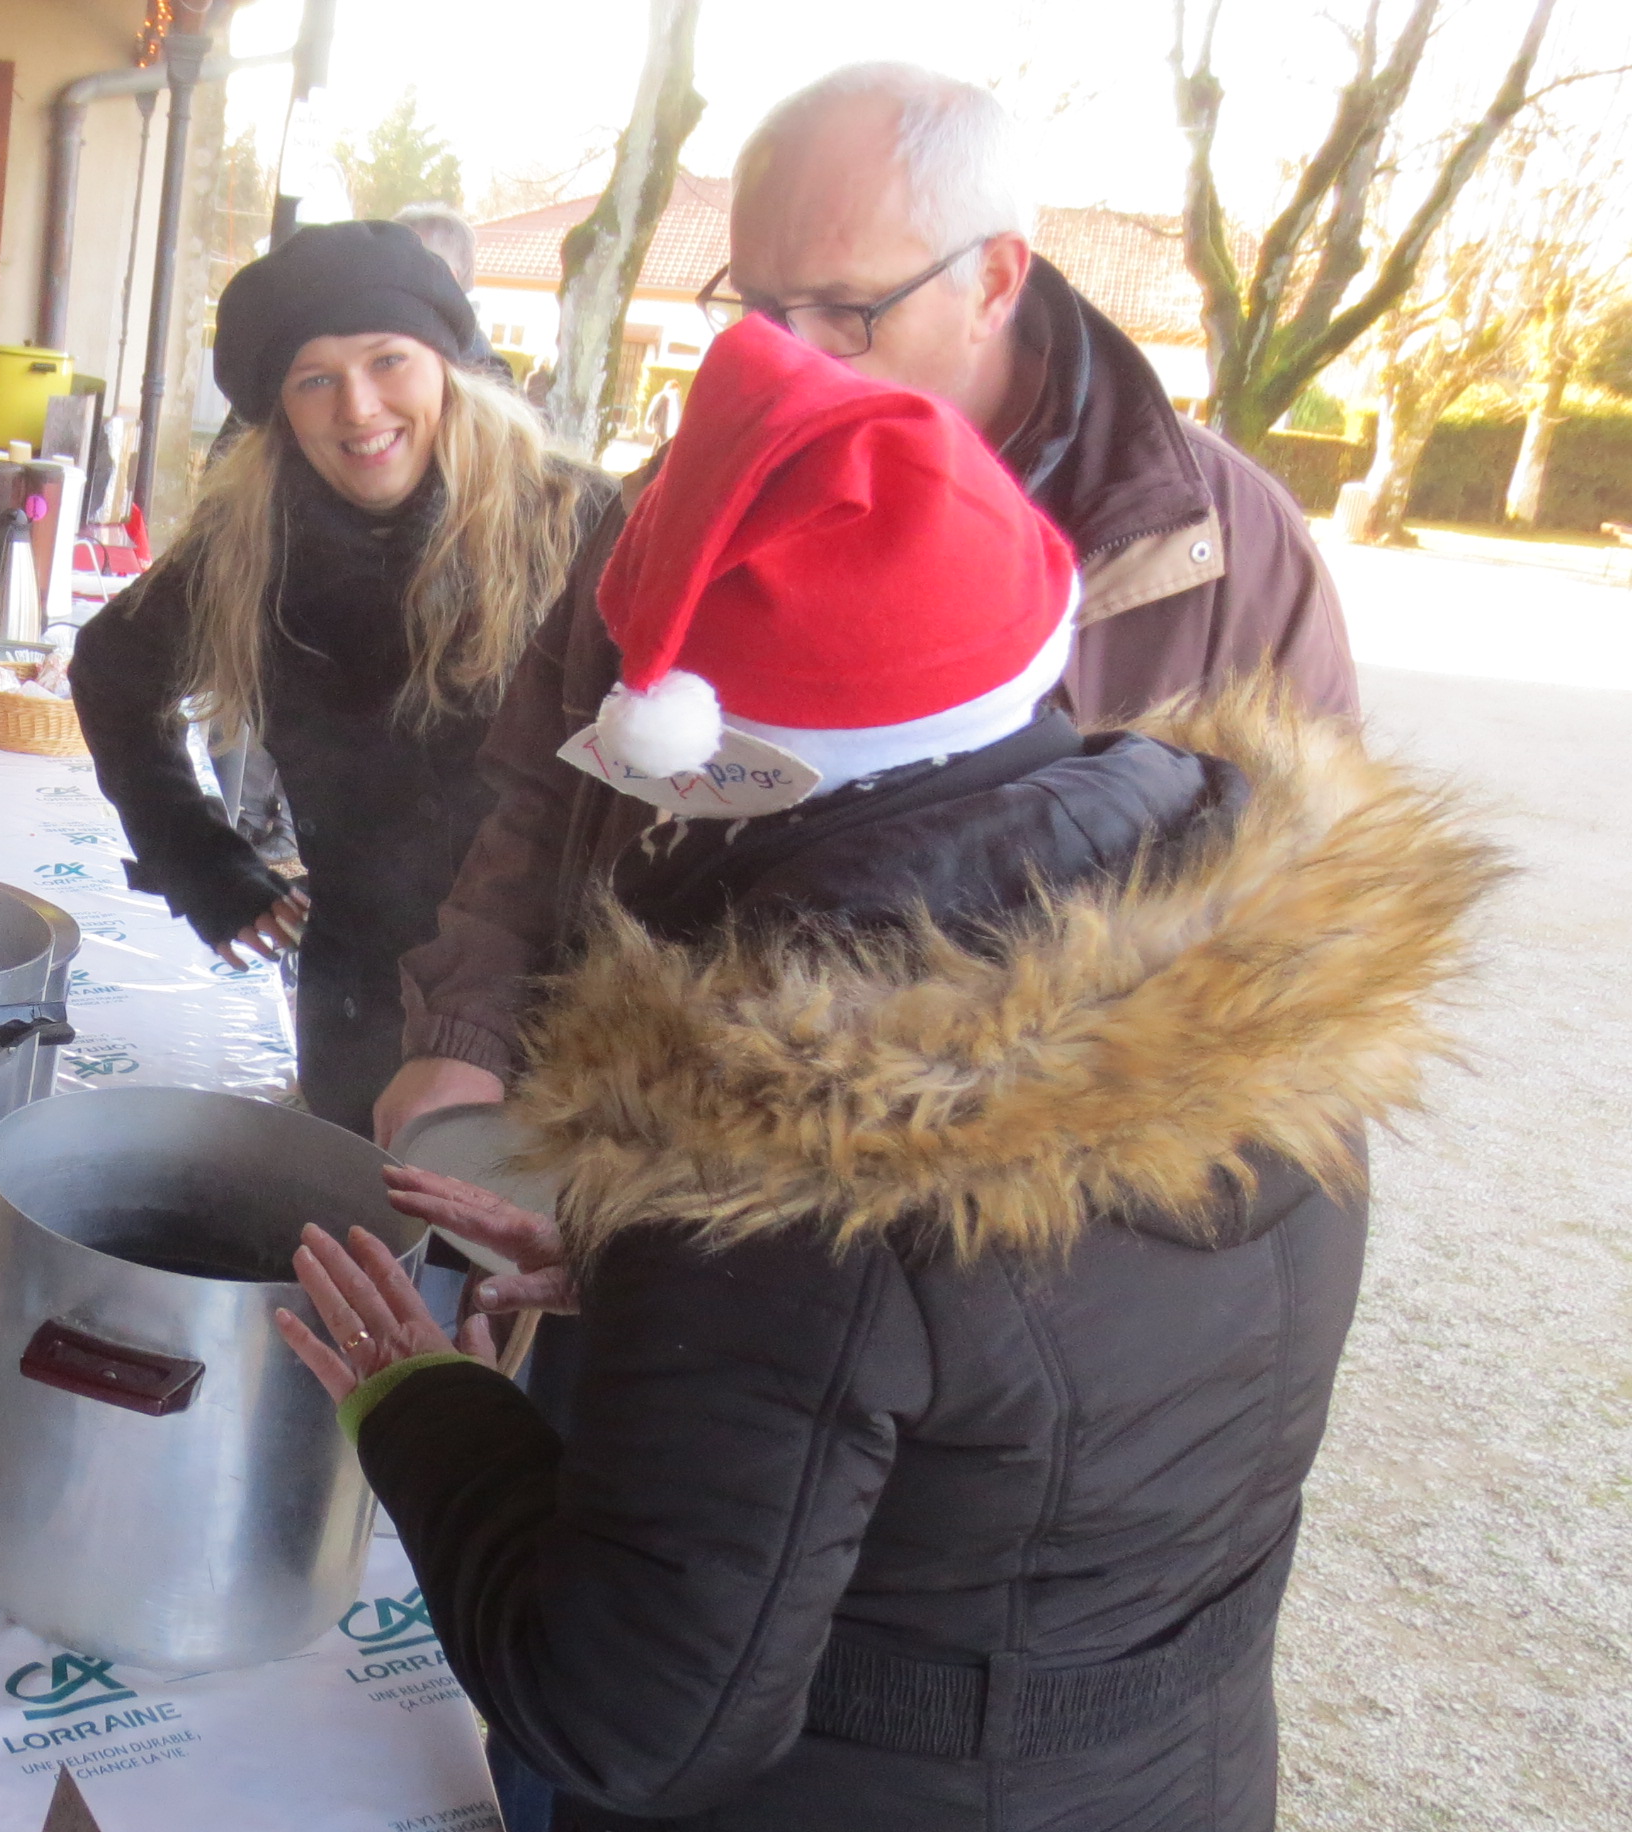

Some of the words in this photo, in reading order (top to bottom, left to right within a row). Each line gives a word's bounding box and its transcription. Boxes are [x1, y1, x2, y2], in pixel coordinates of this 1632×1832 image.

[69, 985, 124, 997] RAINE
[345, 1650, 449, 1684] LORRA
[368, 1689, 399, 1703] UNE
[399, 1699, 420, 1713] ÇA
[2, 1702, 182, 1754] LORRAINE
[21, 1760, 54, 1775] UNE
[75, 1759, 141, 1780] CHANGE
[144, 1754, 161, 1766] LA
